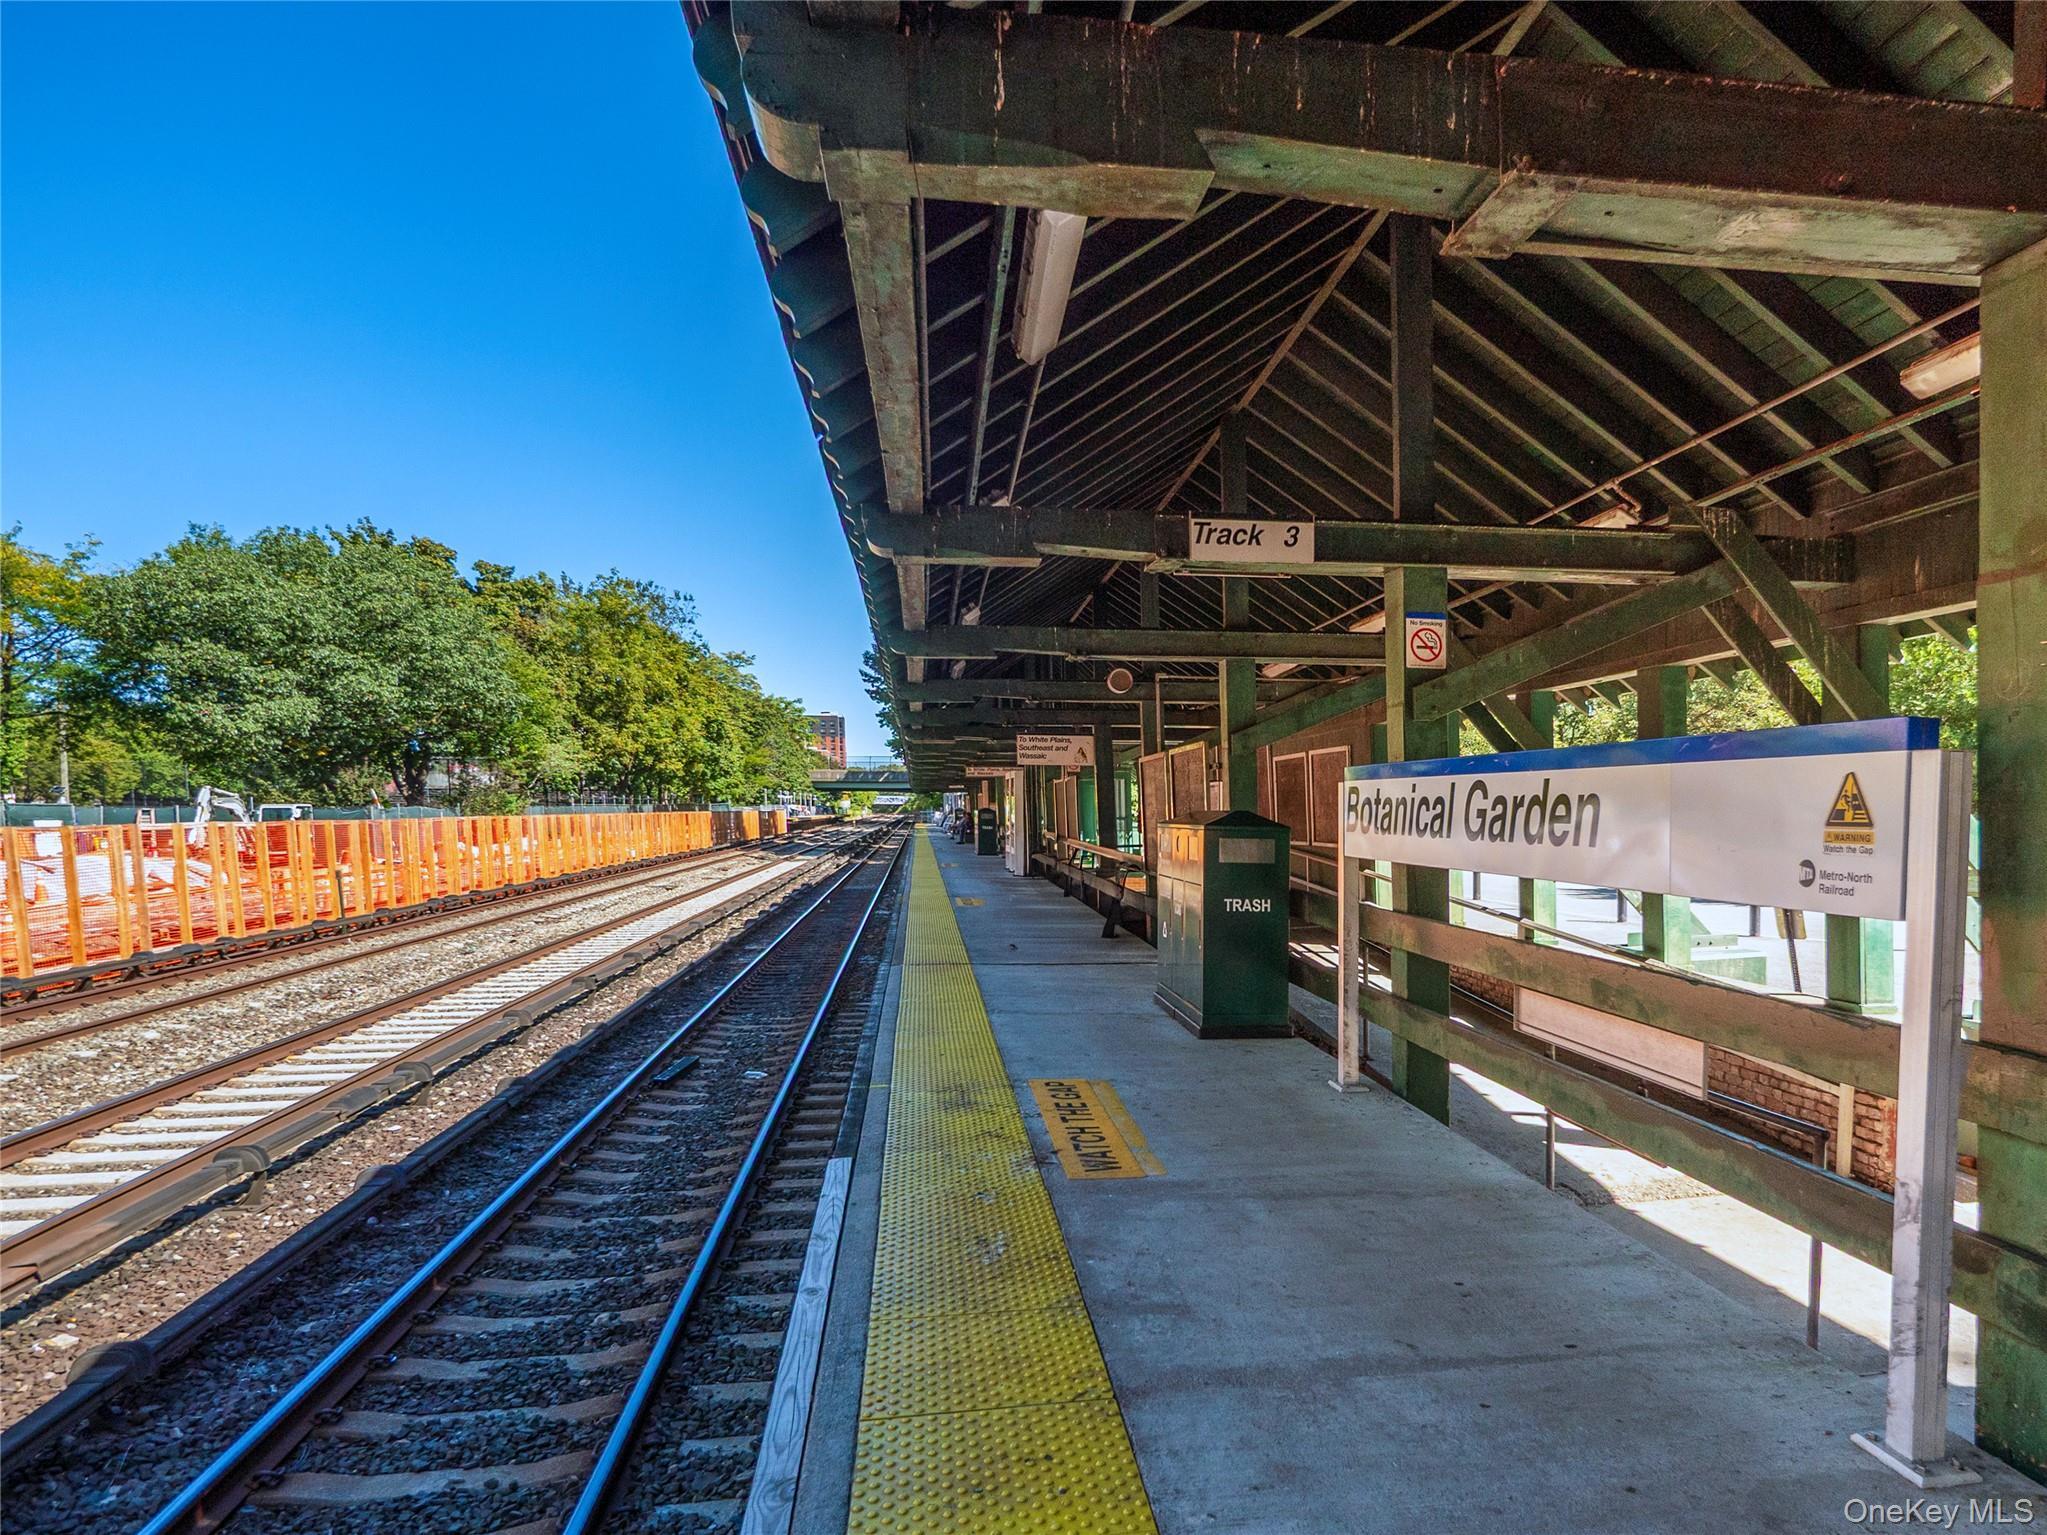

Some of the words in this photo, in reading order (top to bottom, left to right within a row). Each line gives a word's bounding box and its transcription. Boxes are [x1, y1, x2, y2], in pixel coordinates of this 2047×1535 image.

[1193, 521, 1264, 546] Track
[1283, 525, 1300, 547] 3
[1346, 782, 1456, 840] Botanical
[1464, 778, 1601, 848] Garden
[1833, 833, 1872, 843] WARNING
[1823, 844, 1844, 853] Watch
[1845, 846, 1857, 854] the
[1858, 846, 1874, 855] Gap
[1819, 869, 1873, 884] Metro-North
[1818, 883, 1855, 897] Railroad
[1223, 898, 1271, 912] TRASH
[1044, 1081, 1082, 1099] GAP
[1054, 1102, 1095, 1123] THE
[1065, 1126, 1122, 1173] WATCH
